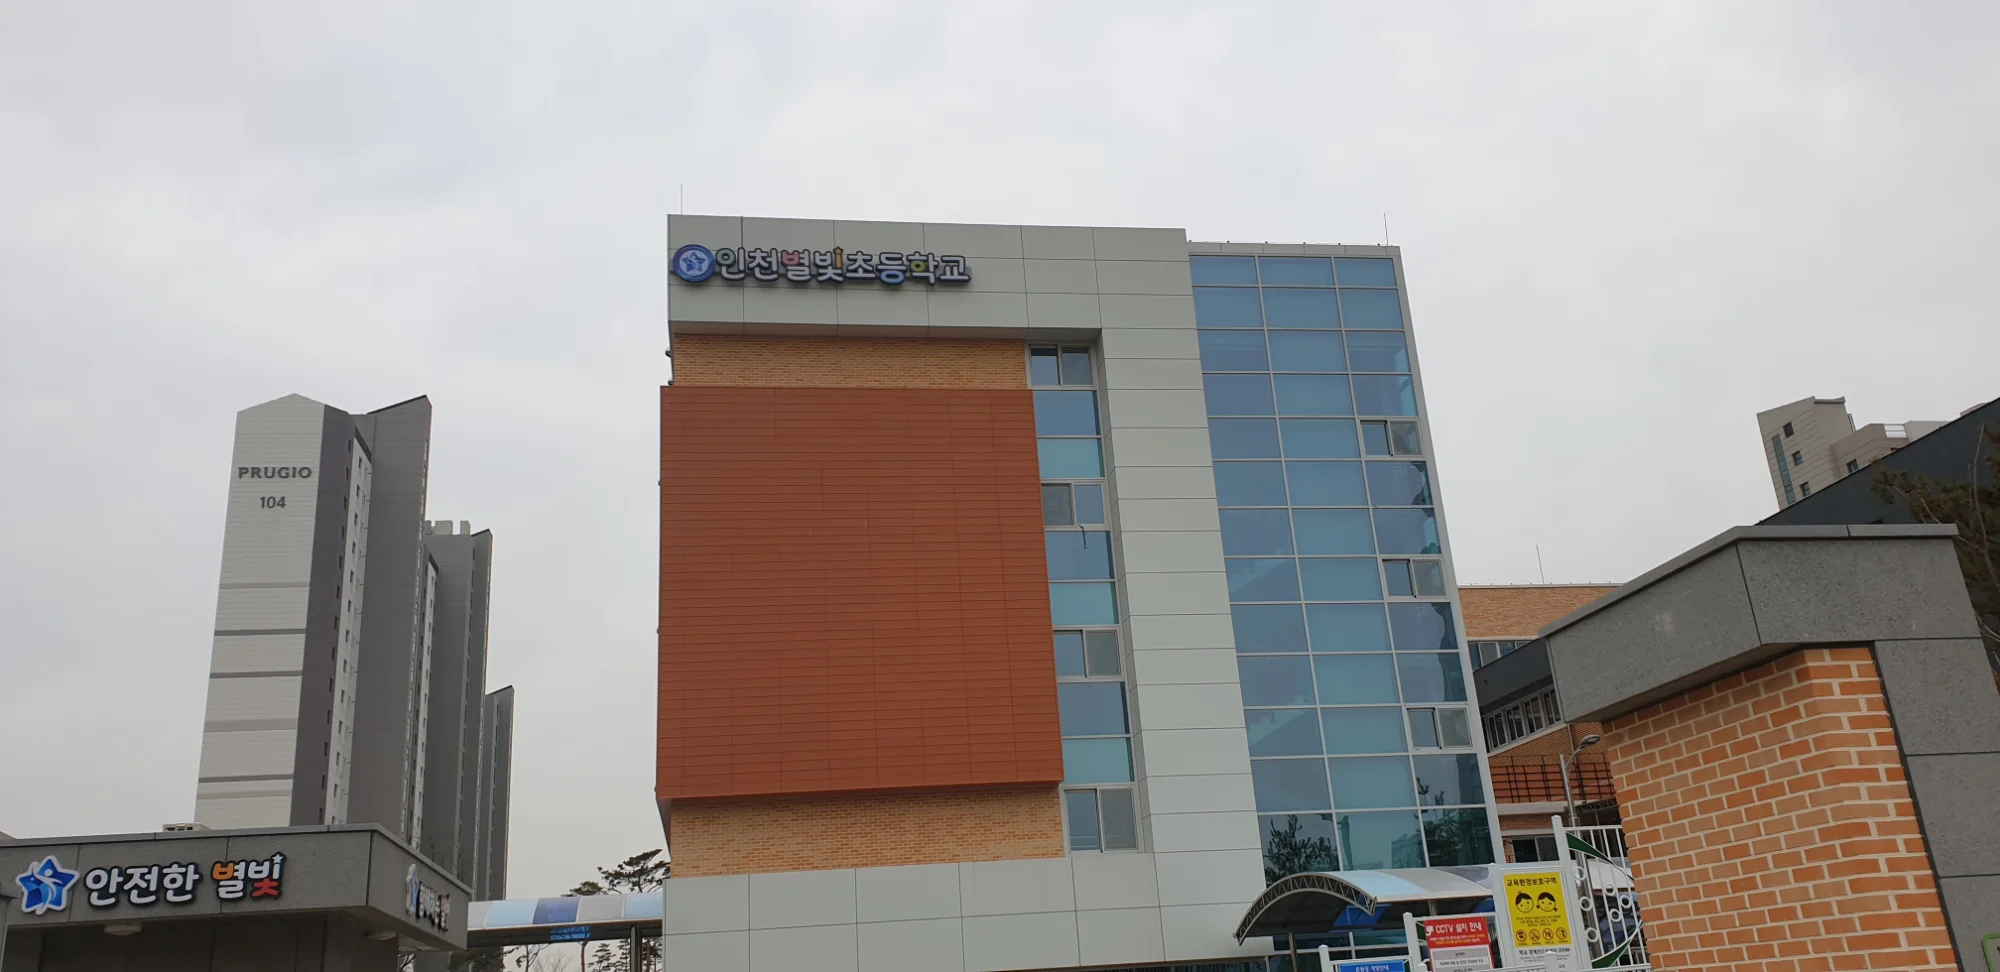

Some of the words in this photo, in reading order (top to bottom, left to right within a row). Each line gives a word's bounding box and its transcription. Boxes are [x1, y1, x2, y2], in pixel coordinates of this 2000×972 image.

[715, 246, 971, 285] 인천별빛초등학교
[238, 466, 312, 479] PRUGIO
[260, 496, 286, 509] 104
[84, 863, 202, 906] 안전한
[211, 852, 286, 900] 별빛
[1506, 877, 1557, 887] 교육환경보호구역
[1435, 924, 1454, 934] CCTV
[1455, 922, 1468, 933] 설치
[1469, 921, 1482, 932] 안내
